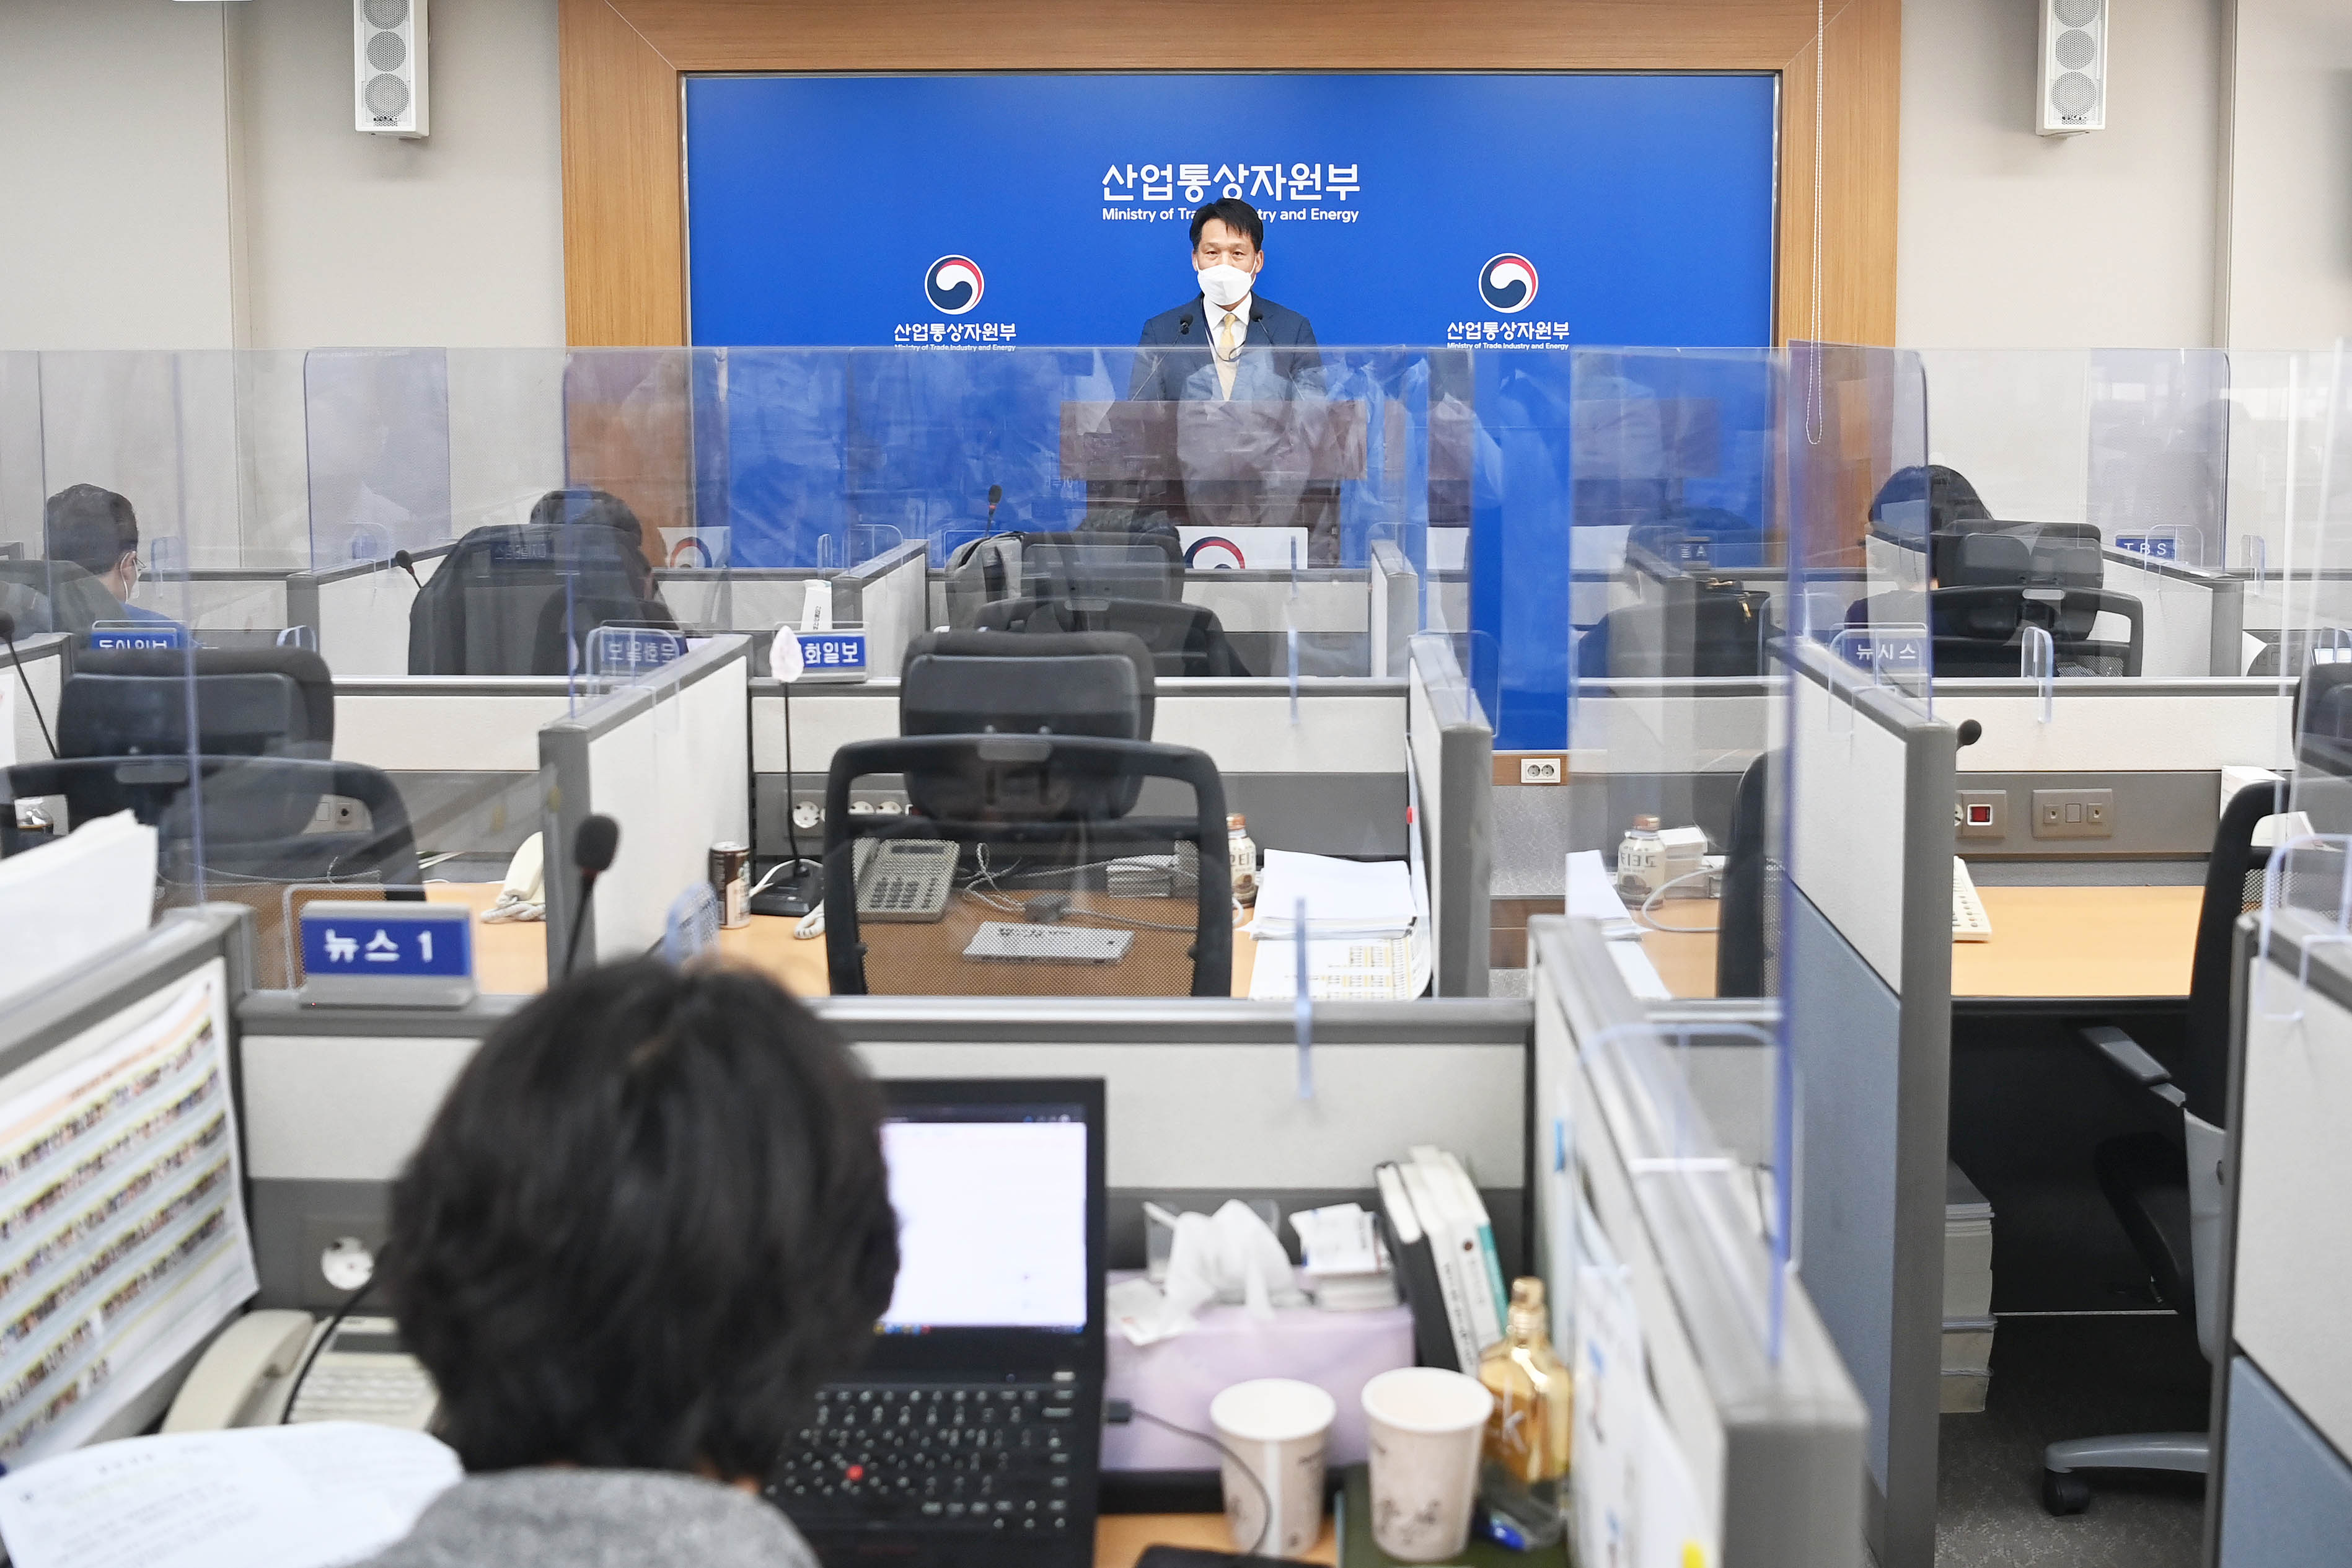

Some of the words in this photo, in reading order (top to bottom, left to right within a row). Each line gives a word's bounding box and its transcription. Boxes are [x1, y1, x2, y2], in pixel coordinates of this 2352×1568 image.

[1102, 163, 1360, 203] 산업통상자원부
[1102, 208, 1156, 222] Ministry
[1160, 208, 1174, 220] of
[1280, 208, 1306, 220] and
[1310, 208, 1359, 222] Energy
[894, 322, 1017, 342] 산업통상자원부
[1447, 321, 1569, 341] 산업통상자원부
[992, 344, 1016, 352] Energy
[1447, 342, 1473, 351] Ministry
[1545, 342, 1569, 351] Energy
[2124, 543, 2166, 555] TBS
[804, 642, 859, 664] 화일보
[1856, 644, 1916, 660] 뉴시스
[324, 928, 400, 963] 뉴스
[416, 929, 434, 963] 1
